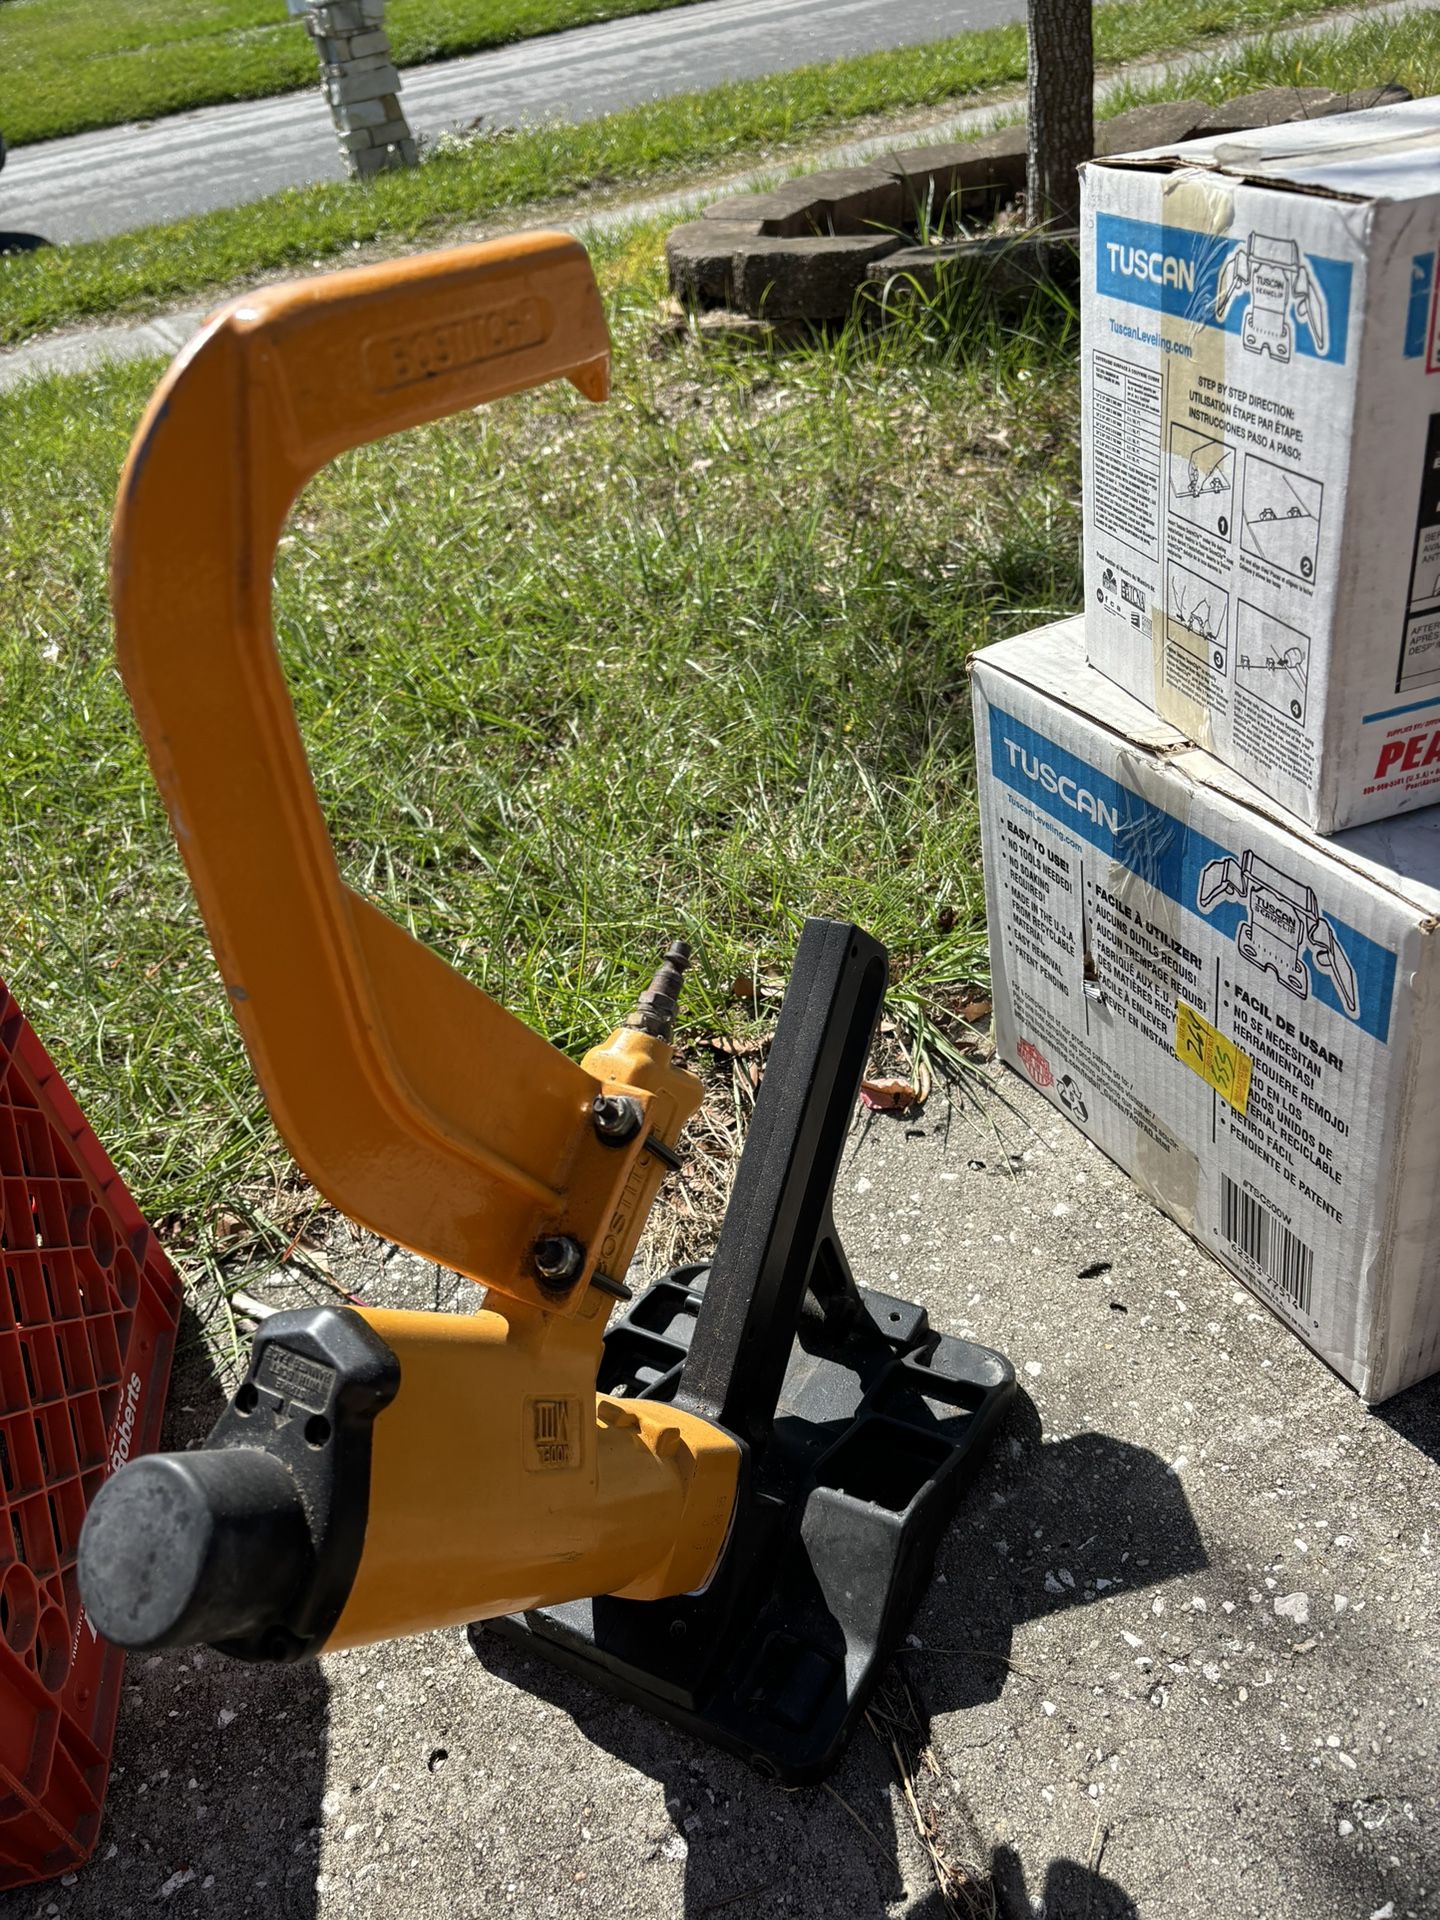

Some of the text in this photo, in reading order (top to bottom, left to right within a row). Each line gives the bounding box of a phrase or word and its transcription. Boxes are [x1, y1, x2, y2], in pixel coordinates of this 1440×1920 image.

[1106, 242, 1195, 293] TUSCAN
[1255, 275, 1285, 291] TUSCAN
[1109, 317, 1193, 358] TuscanLeveling.com
[1189, 389, 1304, 443] UTILISATION ÉTAPE PAR ÉTAPE:
[1198, 375, 1295, 421] STEP BY STEP DIRECTION:
[1188, 406, 1246, 439] INSTRUCCIONES
[1247, 429, 1268, 448] PASO
[1276, 443, 1302, 462] PASO:
[1374, 730, 1440, 779] PEA
[1003, 736, 1118, 836] TUSCAN
[1007, 793, 1083, 853] TuscanLeveling.com
[1007, 820, 1069, 874] EASY TO USE!
[1008, 837, 1072, 894] NO TOOLS NEEDED!
[1009, 855, 1049, 894] NO SOAKING
[1010, 869, 1046, 904] REQUIRED!
[1011, 885, 1076, 945] MADE IN THE U.S.A.
[1012, 899, 1075, 957] FROM RECYCLABLE
[1013, 912, 1045, 946] MATERIAL
[1095, 884, 1203, 970] FACILE À UTILIZER!
[1256, 894, 1296, 928] TUSCAN
[1014, 928, 1063, 976] EASY REMOVAL
[1015, 944, 1069, 997] PATENT PENDING
[1095, 903, 1197, 987] AUCUNS OUTILS REQUIS!
[1096, 922, 1207, 1013] AUCUN TREMPAGE REQUIS!
[1097, 939, 1135, 977] FABRIQUÉ
[1136, 970, 1153, 992] AUX
[1154, 984, 1172, 1006] E.U.
[1097, 954, 1112, 973] DES
[1113, 966, 1153, 1005] MATIÈRES
[1154, 999, 1177, 1023] RECY
[1099, 971, 1123, 999] FACILE
[1131, 998, 1168, 1035] ENLEVER
[1128, 1011, 1139, 1029] EN
[1140, 1022, 1180, 1062] INSTANCE
[1233, 1021, 1314, 1090] HERRAMIENTAS!
[1234, 984, 1343, 1073] FACIL DE USAR!
[1234, 1005, 1322, 1078] NO SE NECESITAN
[1231, 1106, 1264, 1141] RETIRO
[1248, 1088, 1333, 1162] ADOS UNIDOS DE
[1266, 1086, 1302, 1121] EN LOS
[1300, 1092, 1349, 1137] REMOJO!
[1247, 1101, 1342, 1185] TERIAL RECICLABLE
[1230, 1123, 1343, 1224] PENDIENTE DE PATENTE
[1242, 1179, 1292, 1225] #TSC500W
[112, 1371, 141, 1473] Roberts
